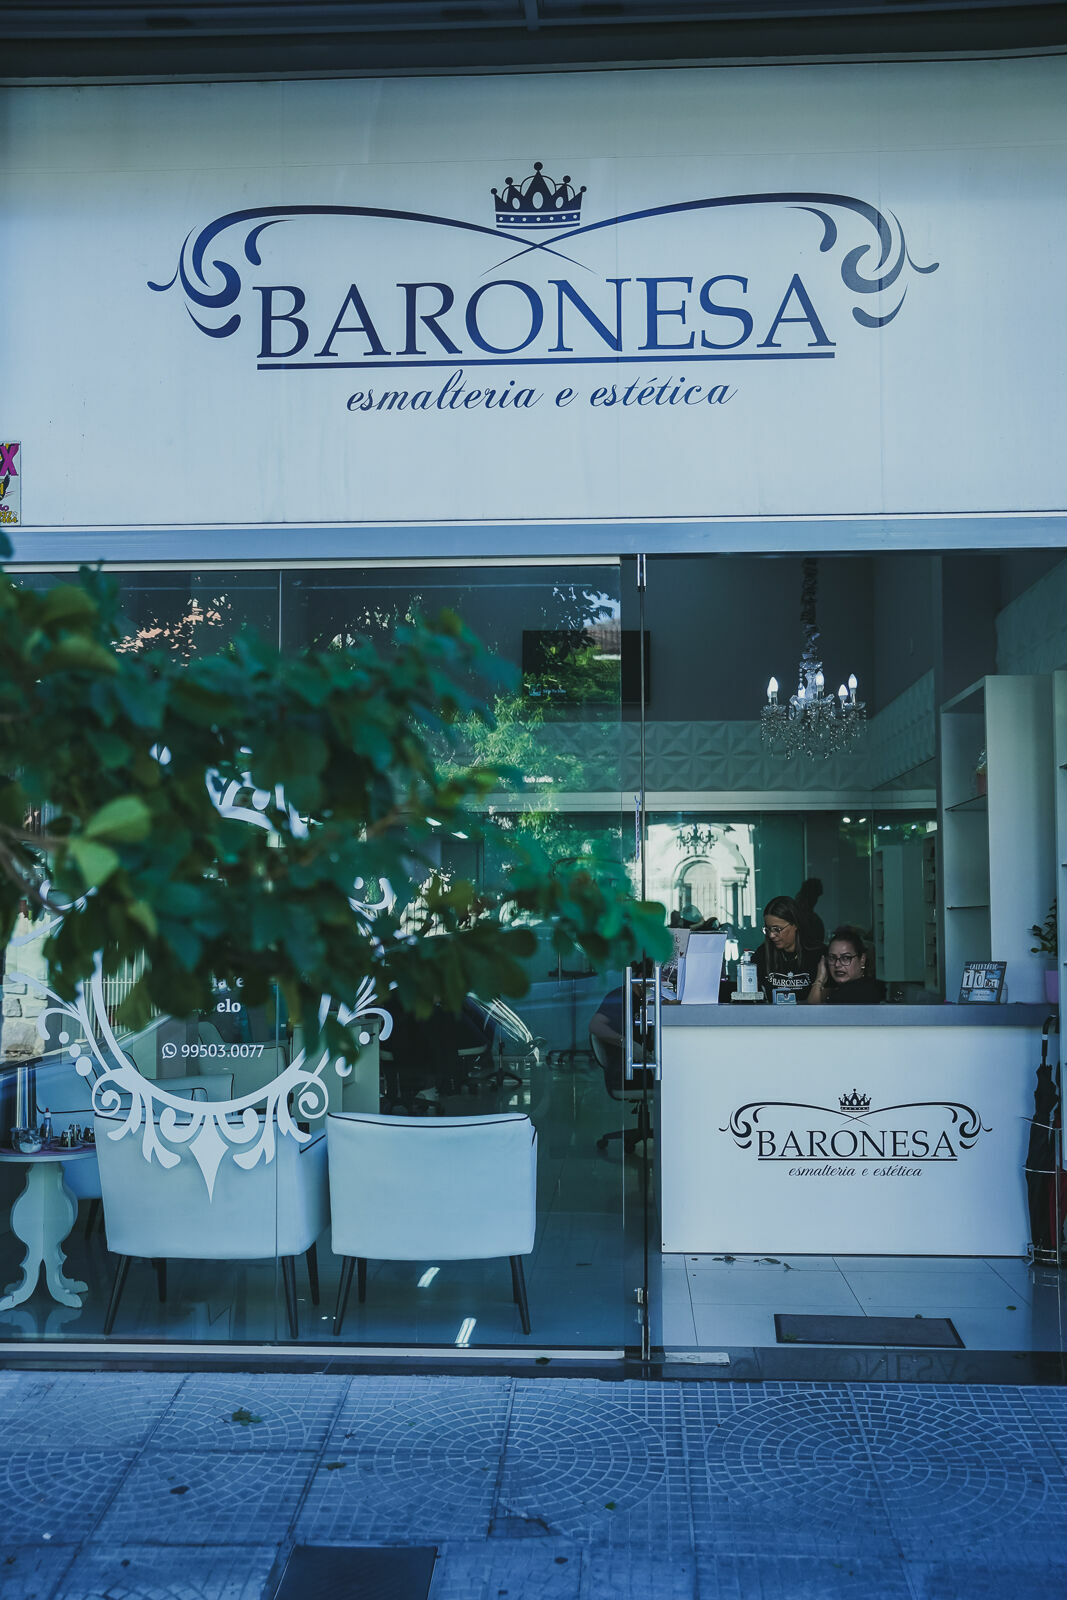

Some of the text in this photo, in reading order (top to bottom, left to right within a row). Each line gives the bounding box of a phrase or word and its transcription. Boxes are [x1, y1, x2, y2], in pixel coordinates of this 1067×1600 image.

[252, 273, 837, 359] BARONESA
[346, 368, 738, 412] esmalteria e estética
[181, 1043, 265, 1058] 99503.0077
[756, 1129, 957, 1158] BARONESA
[788, 1164, 923, 1177] esmalteria e estética
